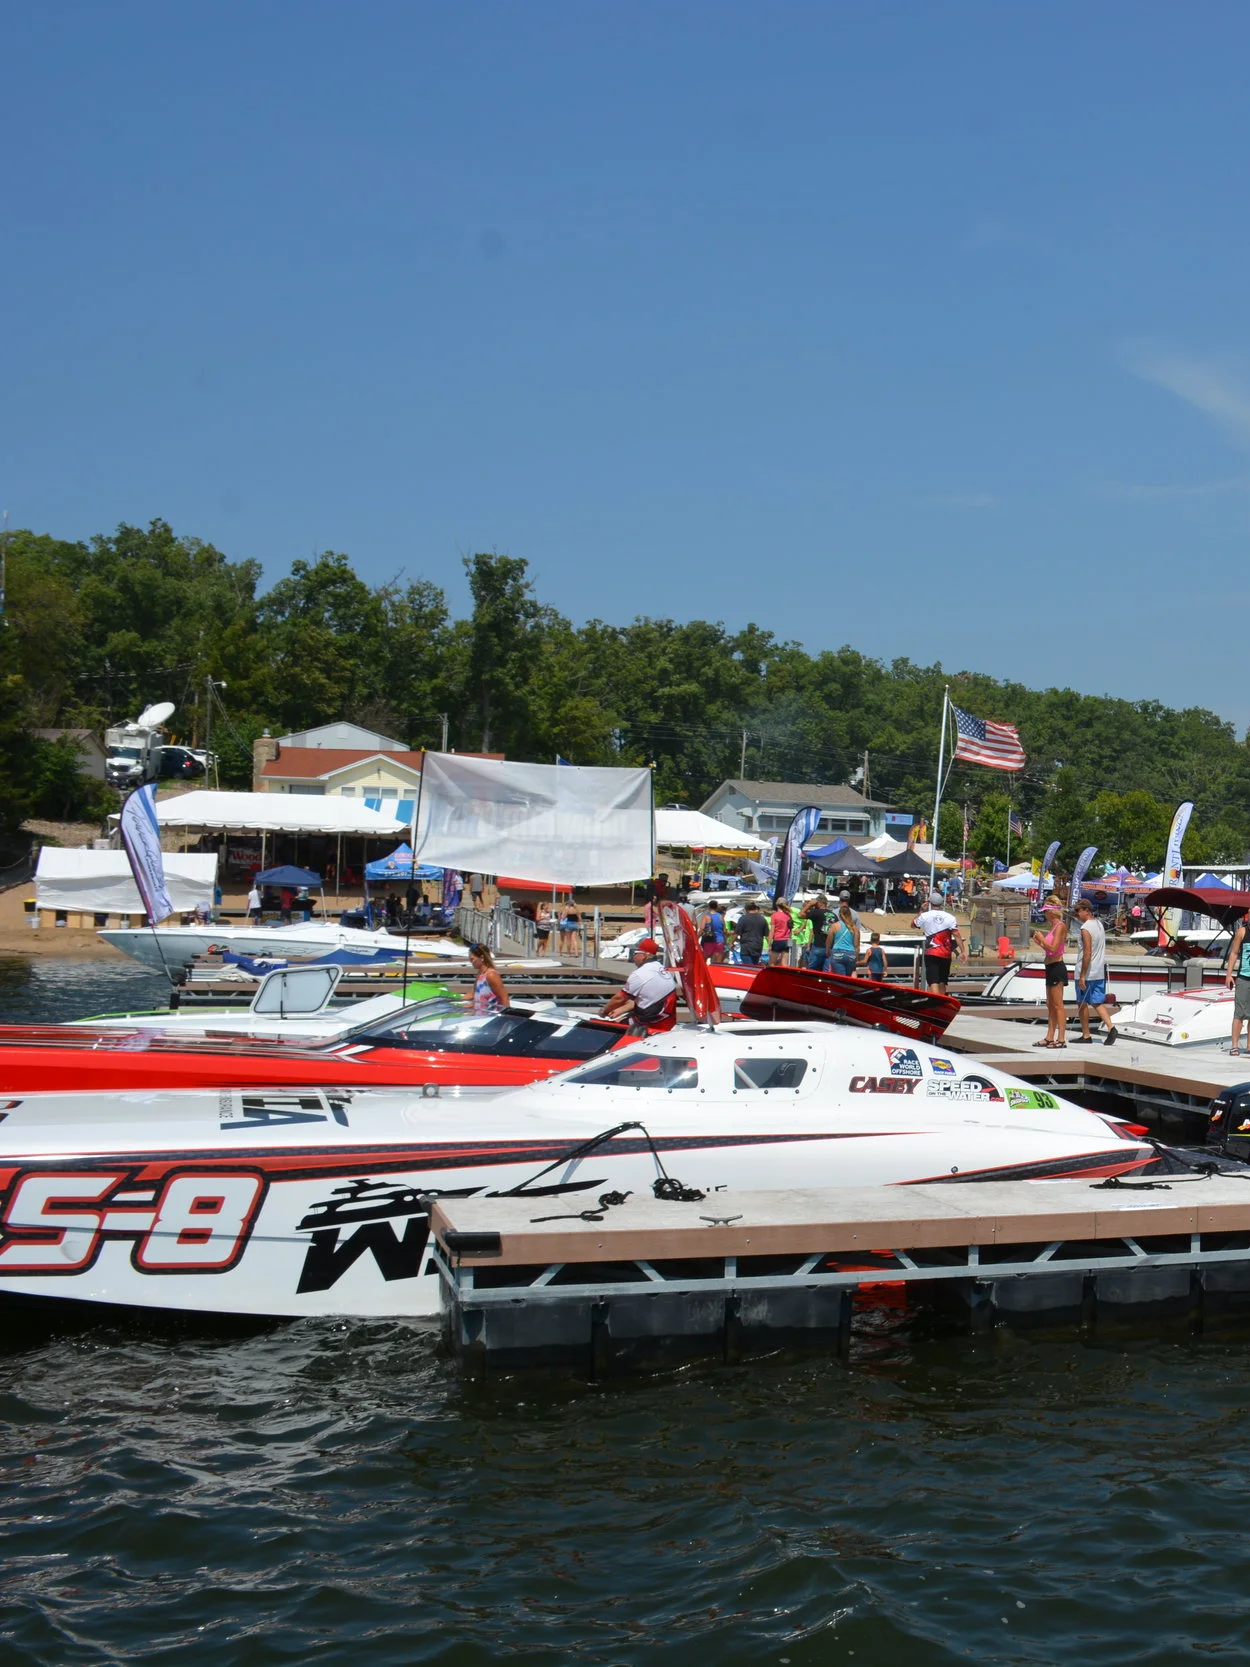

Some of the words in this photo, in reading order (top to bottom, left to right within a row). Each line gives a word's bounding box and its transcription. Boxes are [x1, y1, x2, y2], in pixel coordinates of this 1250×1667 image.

[848, 1076, 924, 1095] CASEY
[927, 1079, 982, 1093] SPEED
[948, 1090, 990, 1102] WATER
[1033, 1091, 1054, 1109] 93
